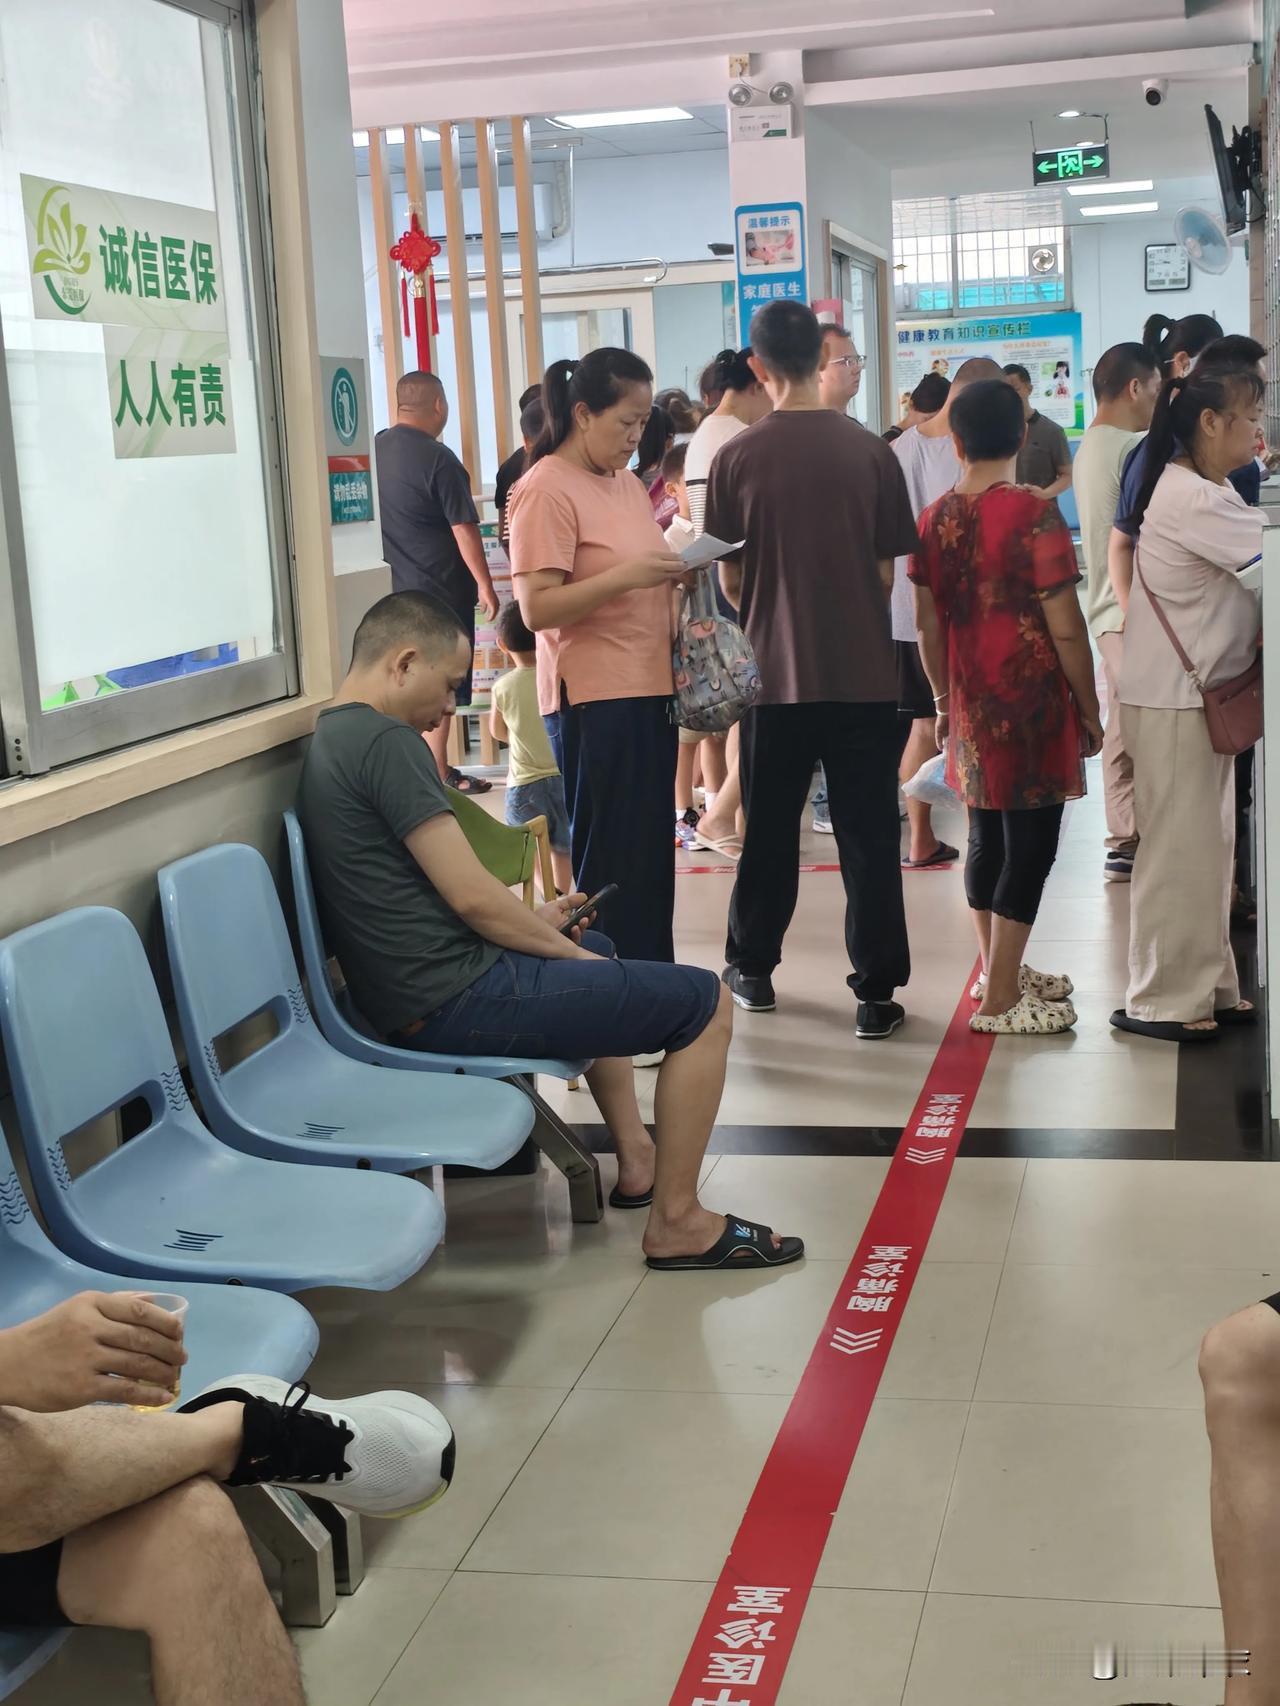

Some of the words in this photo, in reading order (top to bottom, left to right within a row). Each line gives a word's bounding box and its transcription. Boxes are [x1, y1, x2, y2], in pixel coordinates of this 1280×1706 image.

[748, 214, 791, 229] 温馨提示
[99, 225, 217, 304] 诚信医保
[742, 281, 803, 300] 家庭医生
[897, 322, 1032, 344] 健康教育知识宣传栏
[115, 360, 226, 427] 人人有责
[915, 1093, 965, 1138] 胸痛诊室
[847, 1245, 913, 1313] 胸痛诊室
